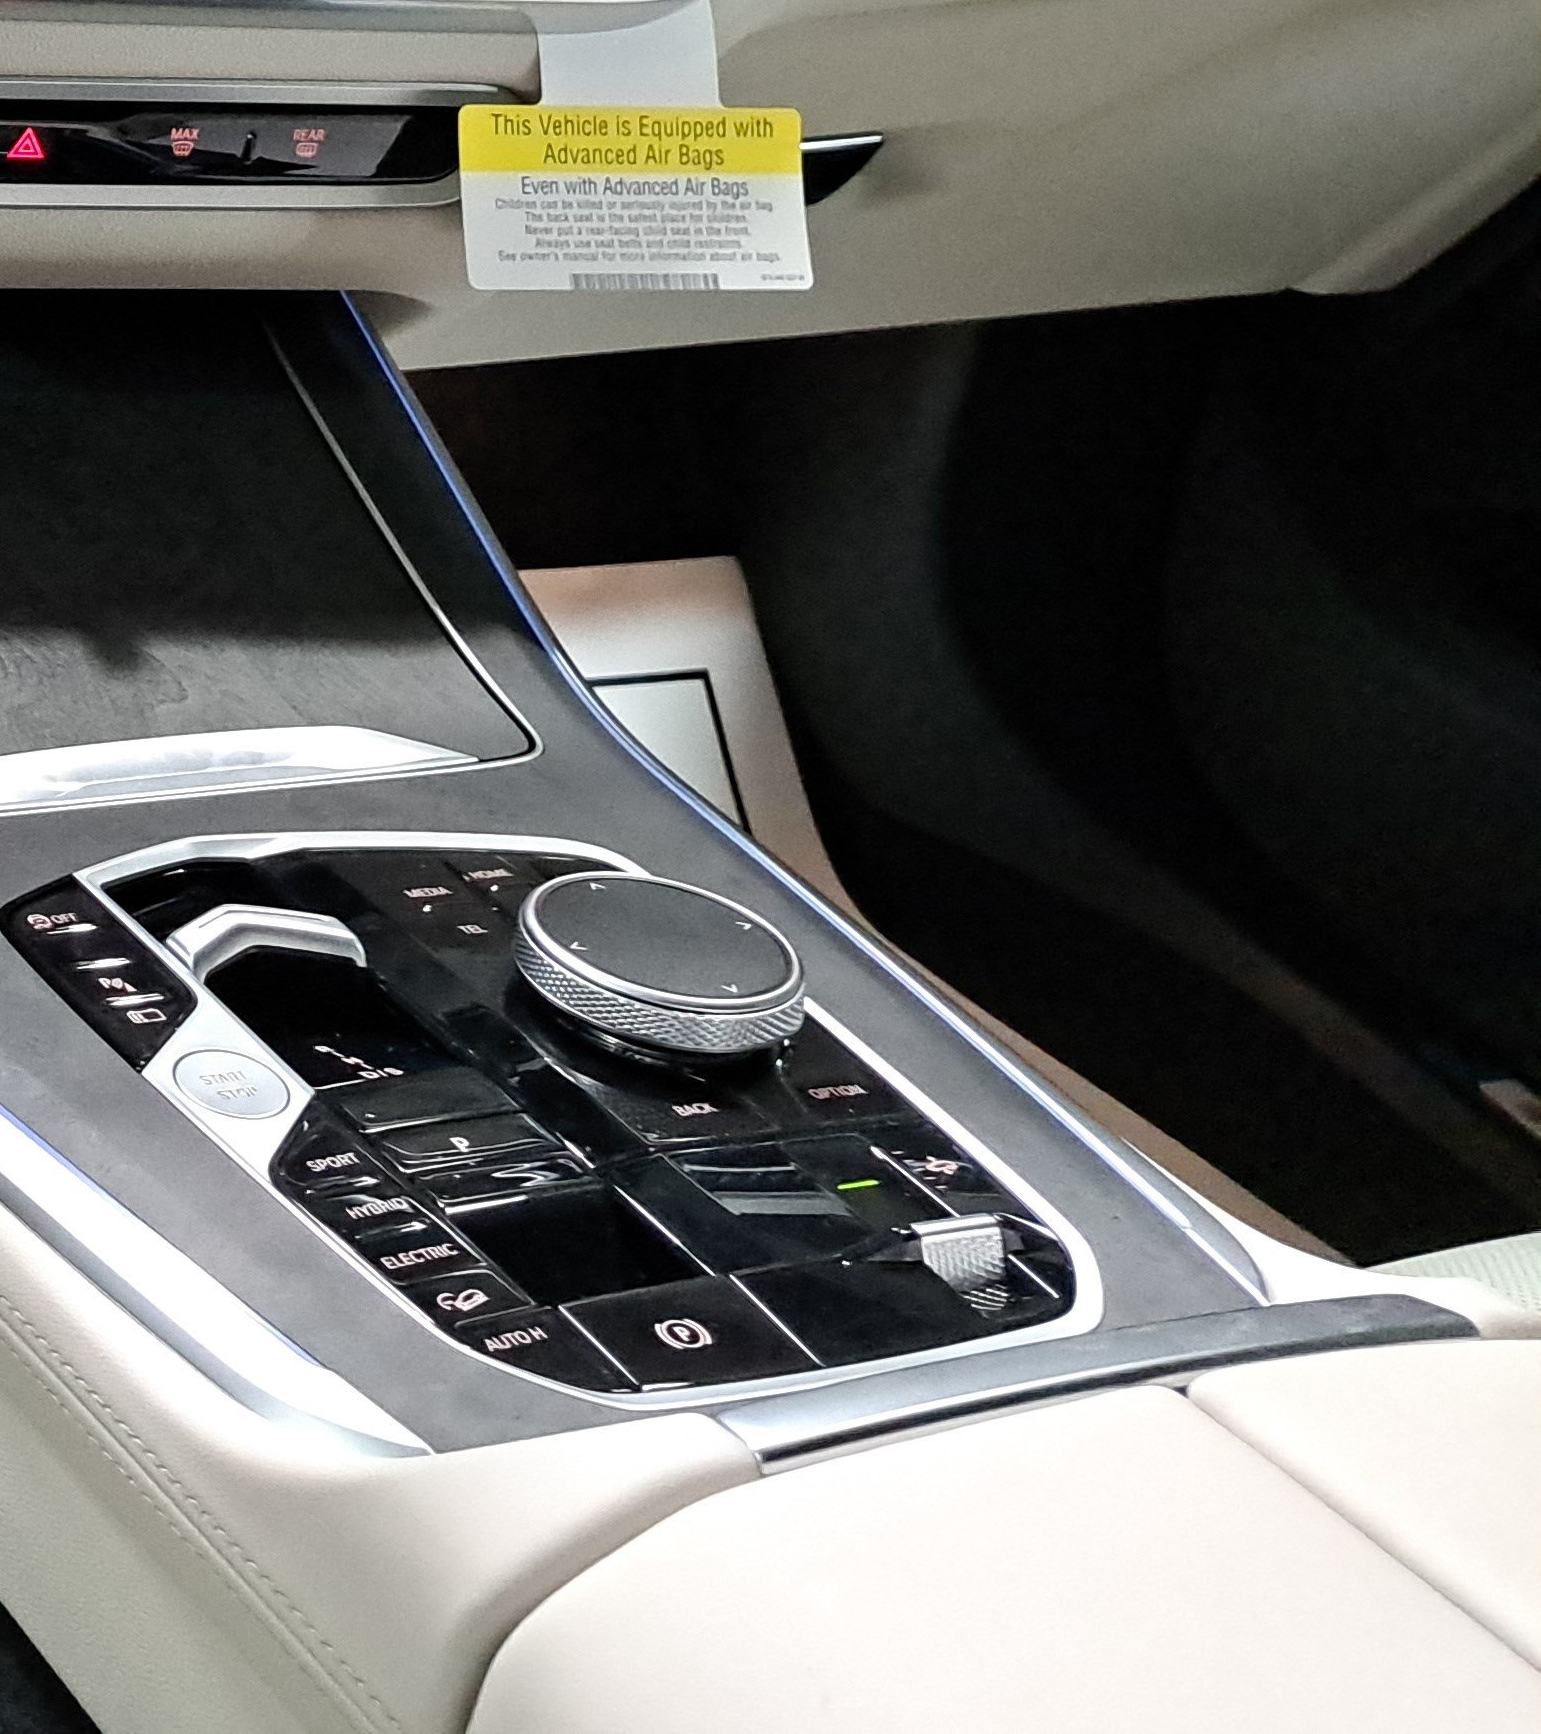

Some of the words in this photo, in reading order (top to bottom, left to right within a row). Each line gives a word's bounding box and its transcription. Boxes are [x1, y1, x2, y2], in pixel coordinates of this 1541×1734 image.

[170, 128, 201, 142] MAX
[292, 128, 326, 142] REAR
[491, 113, 532, 136] This
[539, 114, 609, 136] Vehicle
[616, 115, 631, 136] is
[638, 115, 726, 142] Equipped
[733, 116, 774, 138] with
[543, 142, 637, 165] Advanced
[645, 143, 671, 165] Air
[679, 143, 725, 170] Bags
[521, 176, 559, 195] Even
[564, 176, 597, 195] with
[602, 176, 679, 196] Advanced
[684, 177, 706, 196] Air
[711, 177, 749, 200] Bags
[403, 886, 453, 898] MEDIA
[50, 912, 79, 924] OFF
[457, 924, 489, 934] TEL
[199, 1070, 247, 1085] START
[672, 1102, 719, 1118] BACK
[305, 1151, 360, 1173] SPORT
[345, 1196, 412, 1220] HYBRID
[380, 1243, 459, 1270] ELECTRIC
[483, 1329, 531, 1353] AUTO
